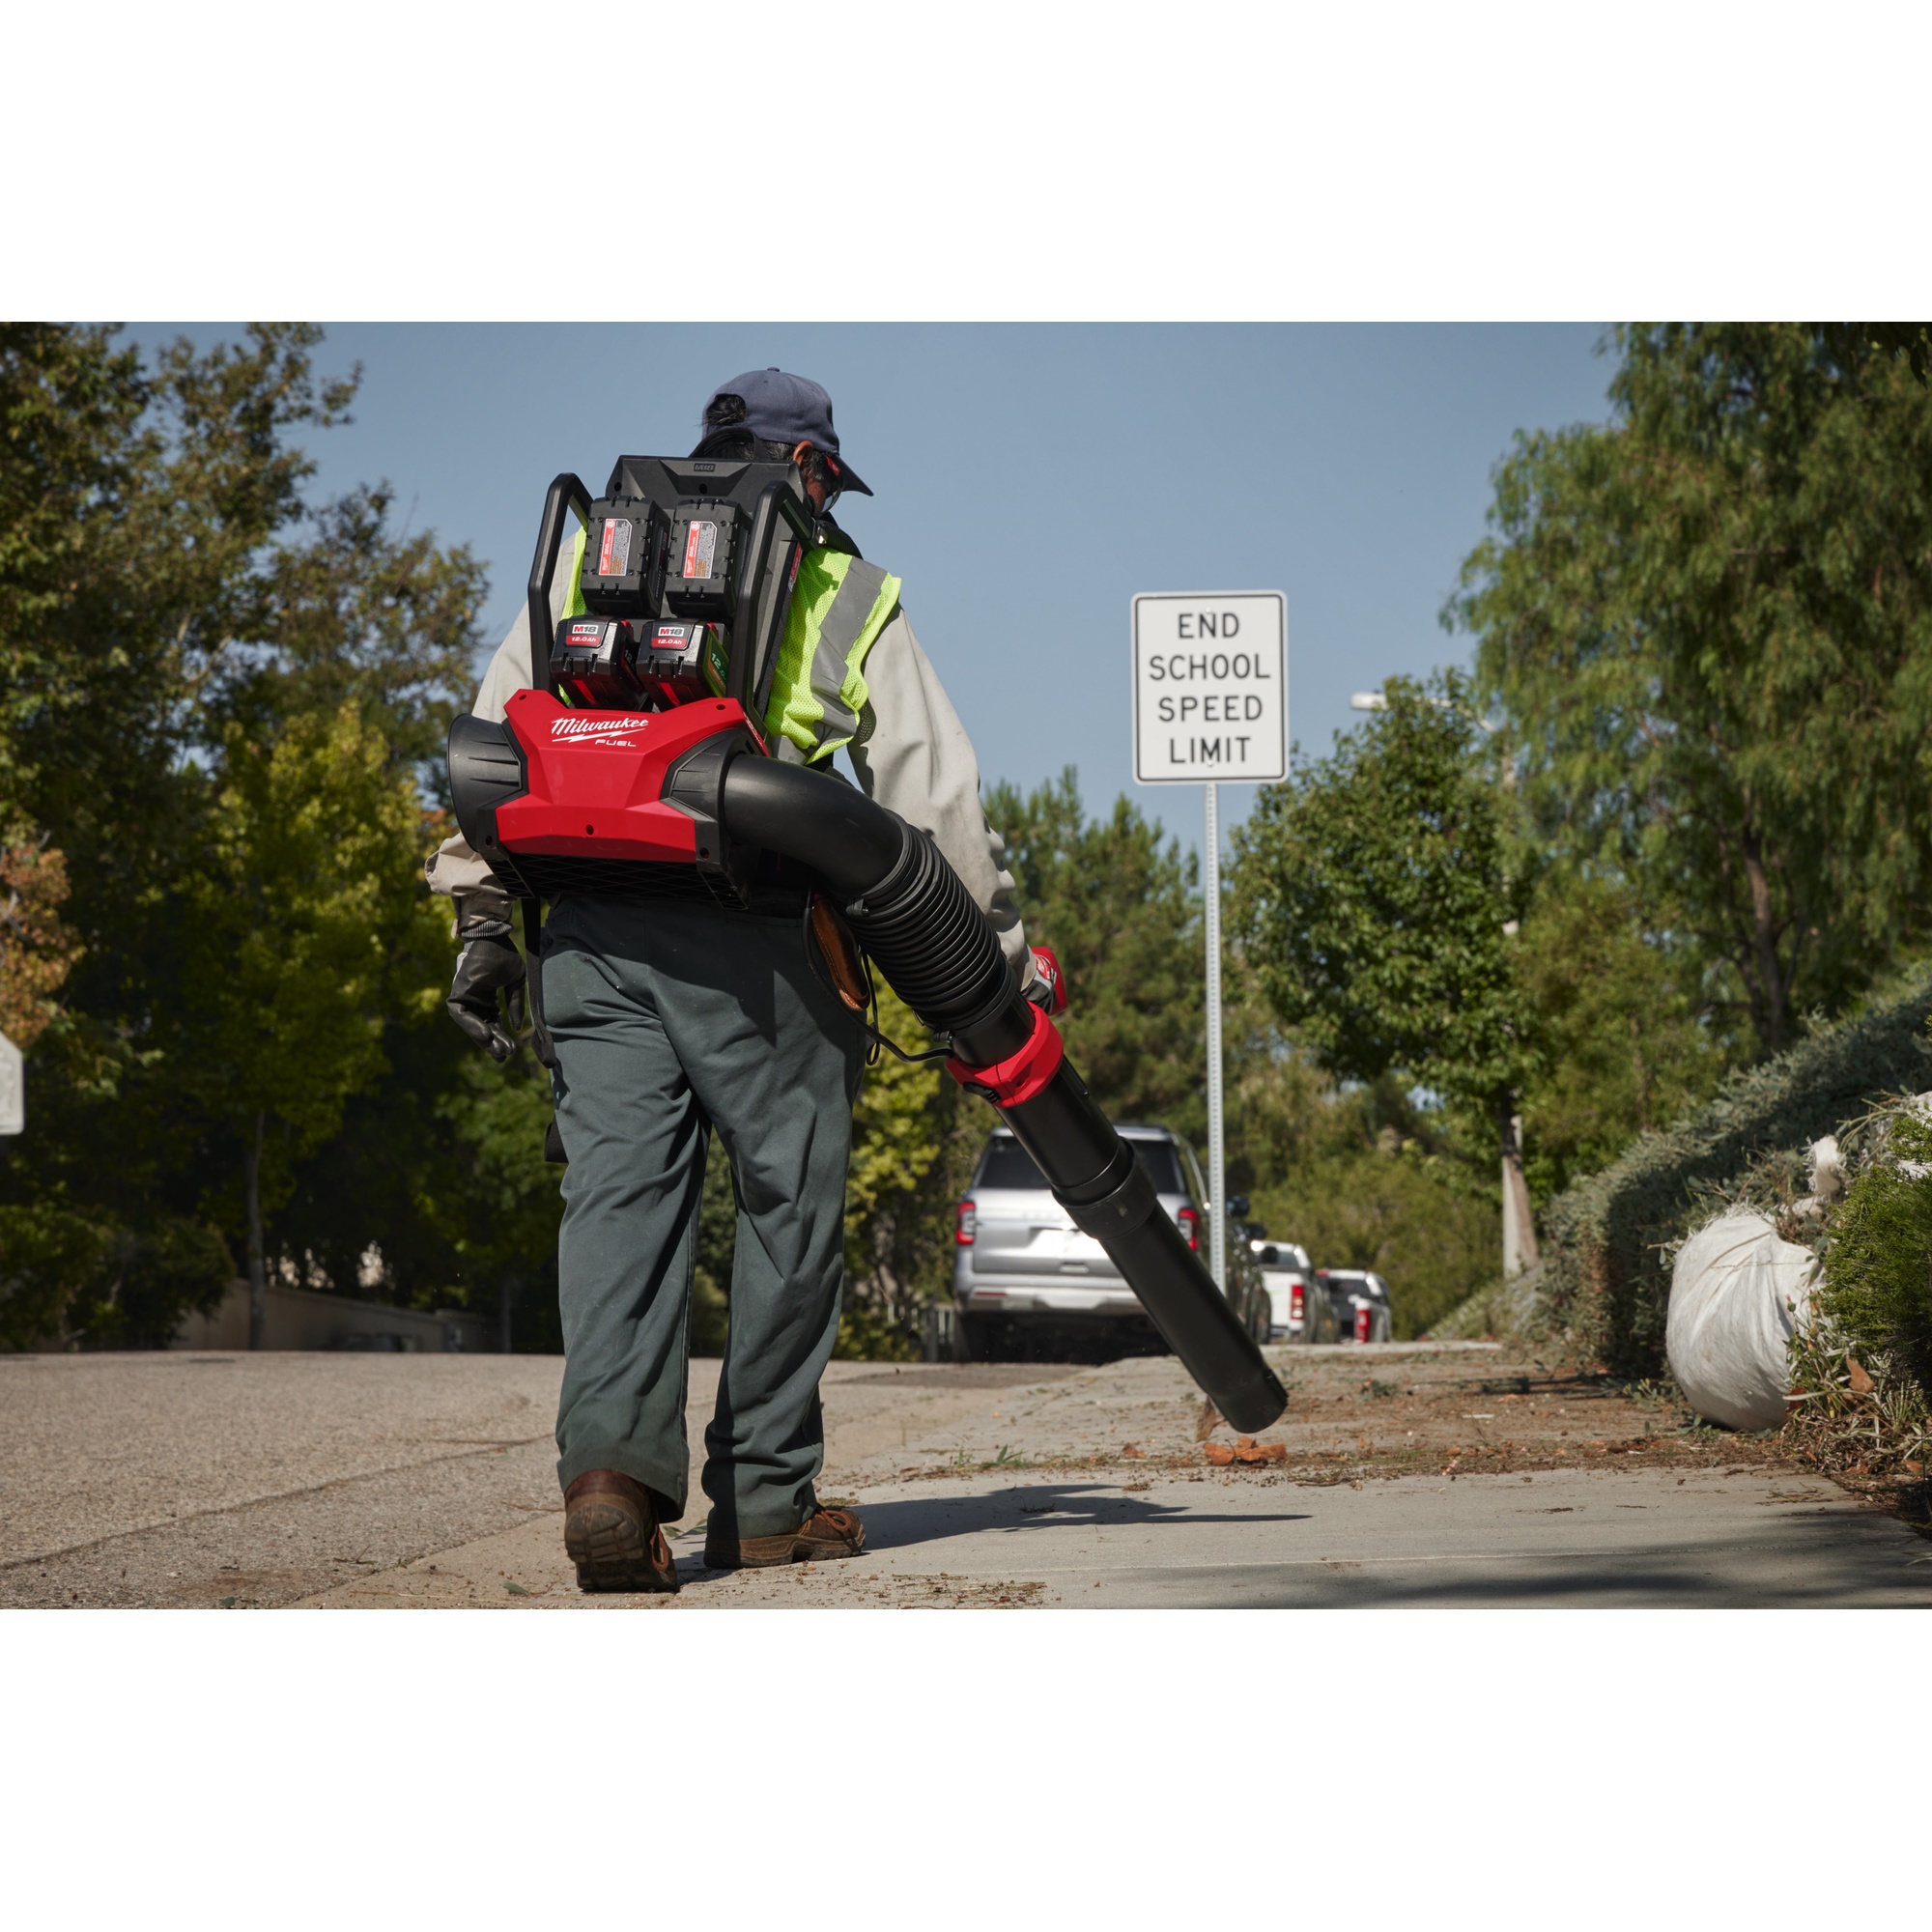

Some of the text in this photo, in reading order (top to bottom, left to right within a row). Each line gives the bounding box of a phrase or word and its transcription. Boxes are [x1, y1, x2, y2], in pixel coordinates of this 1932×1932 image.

[1179, 612, 1239, 639] END
[1150, 653, 1270, 680] SCHOOL
[1158, 696, 1263, 722] SPEED
[551, 718, 649, 735] Milwaukee
[1171, 737, 1250, 764] LIMIT
